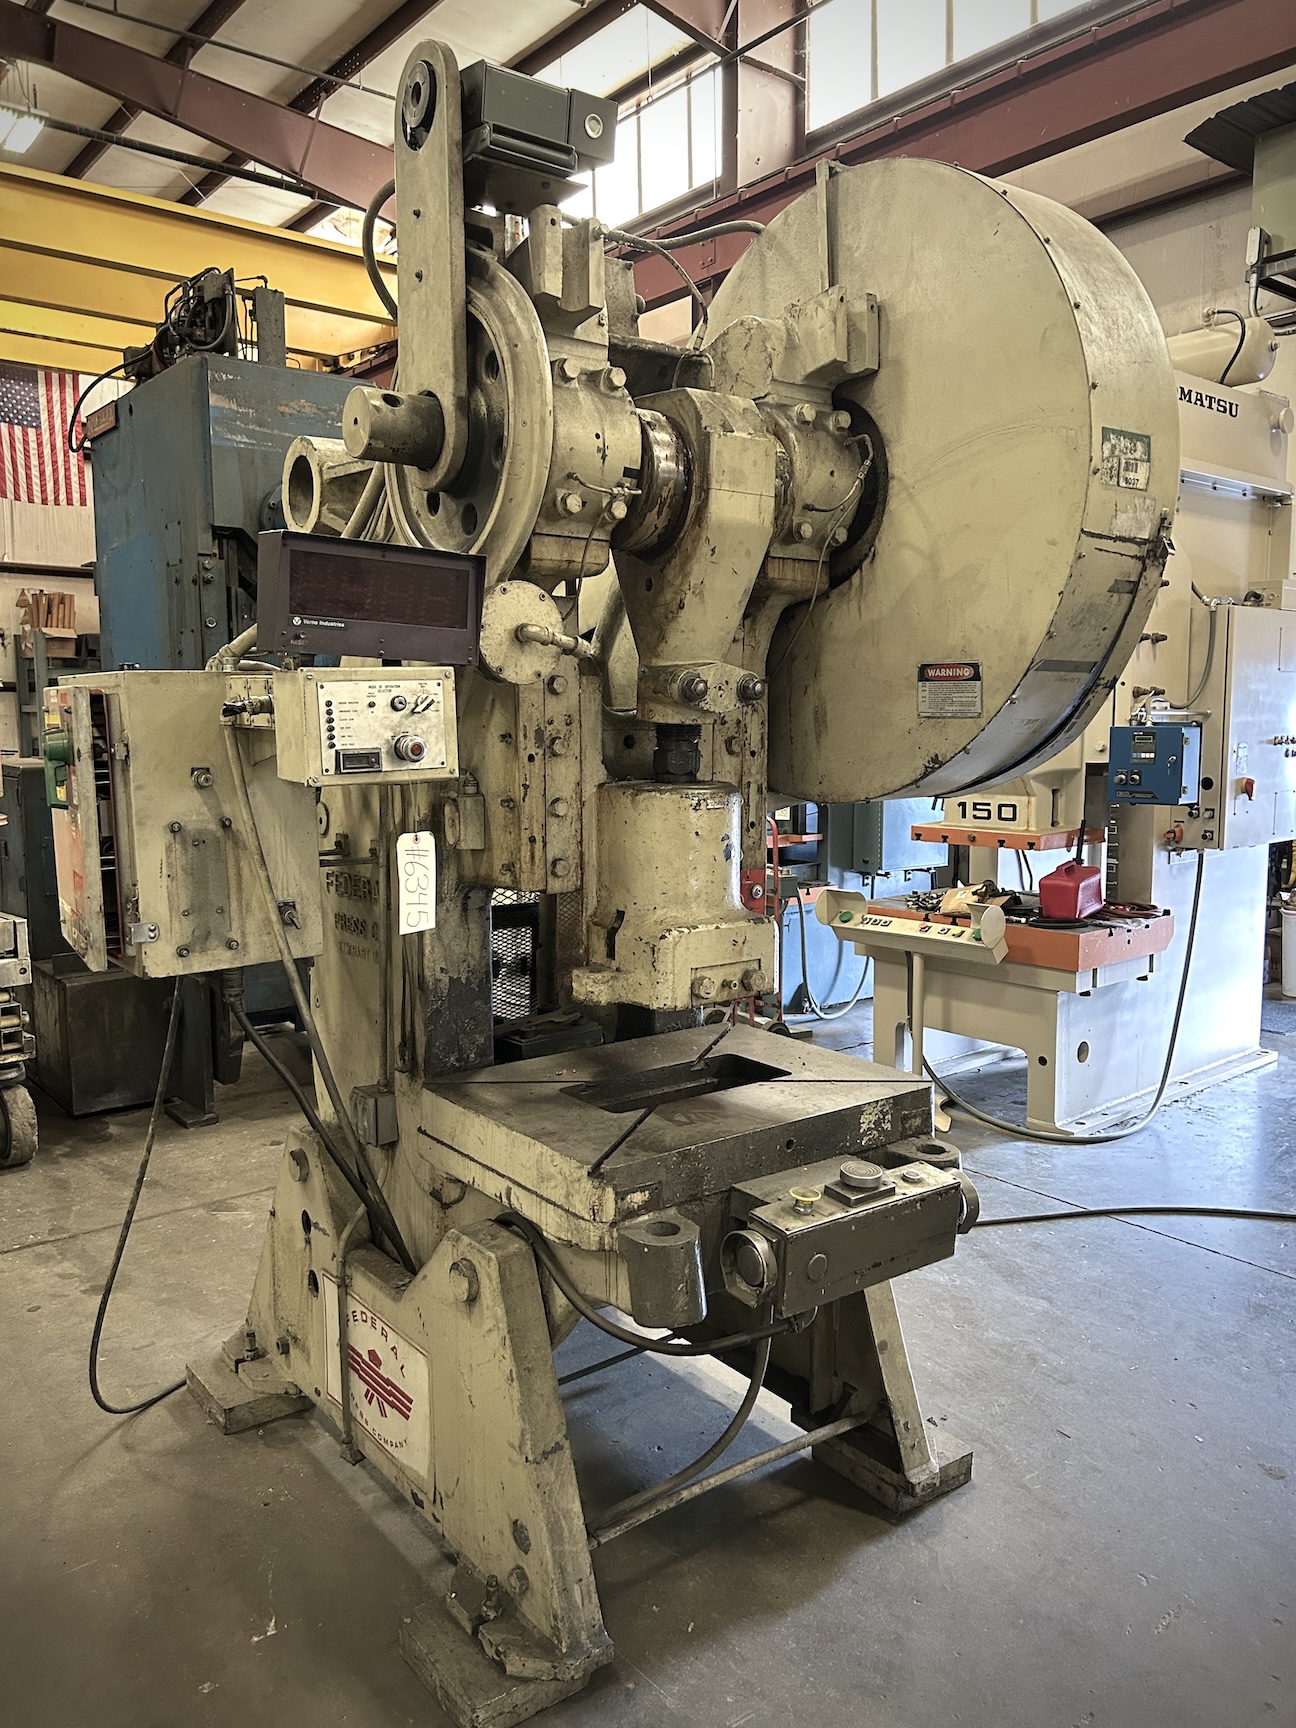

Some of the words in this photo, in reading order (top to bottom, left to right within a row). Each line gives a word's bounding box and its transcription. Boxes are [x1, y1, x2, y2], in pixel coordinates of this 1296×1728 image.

[1177, 386, 1239, 418] MATSU
[319, 620, 345, 628] Industries
[927, 667, 970, 677] WARNING
[957, 801, 1017, 822] 150
[326, 870, 380, 906] FEDERA
[404, 846, 430, 928] #6345
[372, 1428, 408, 1449] COMPANY
